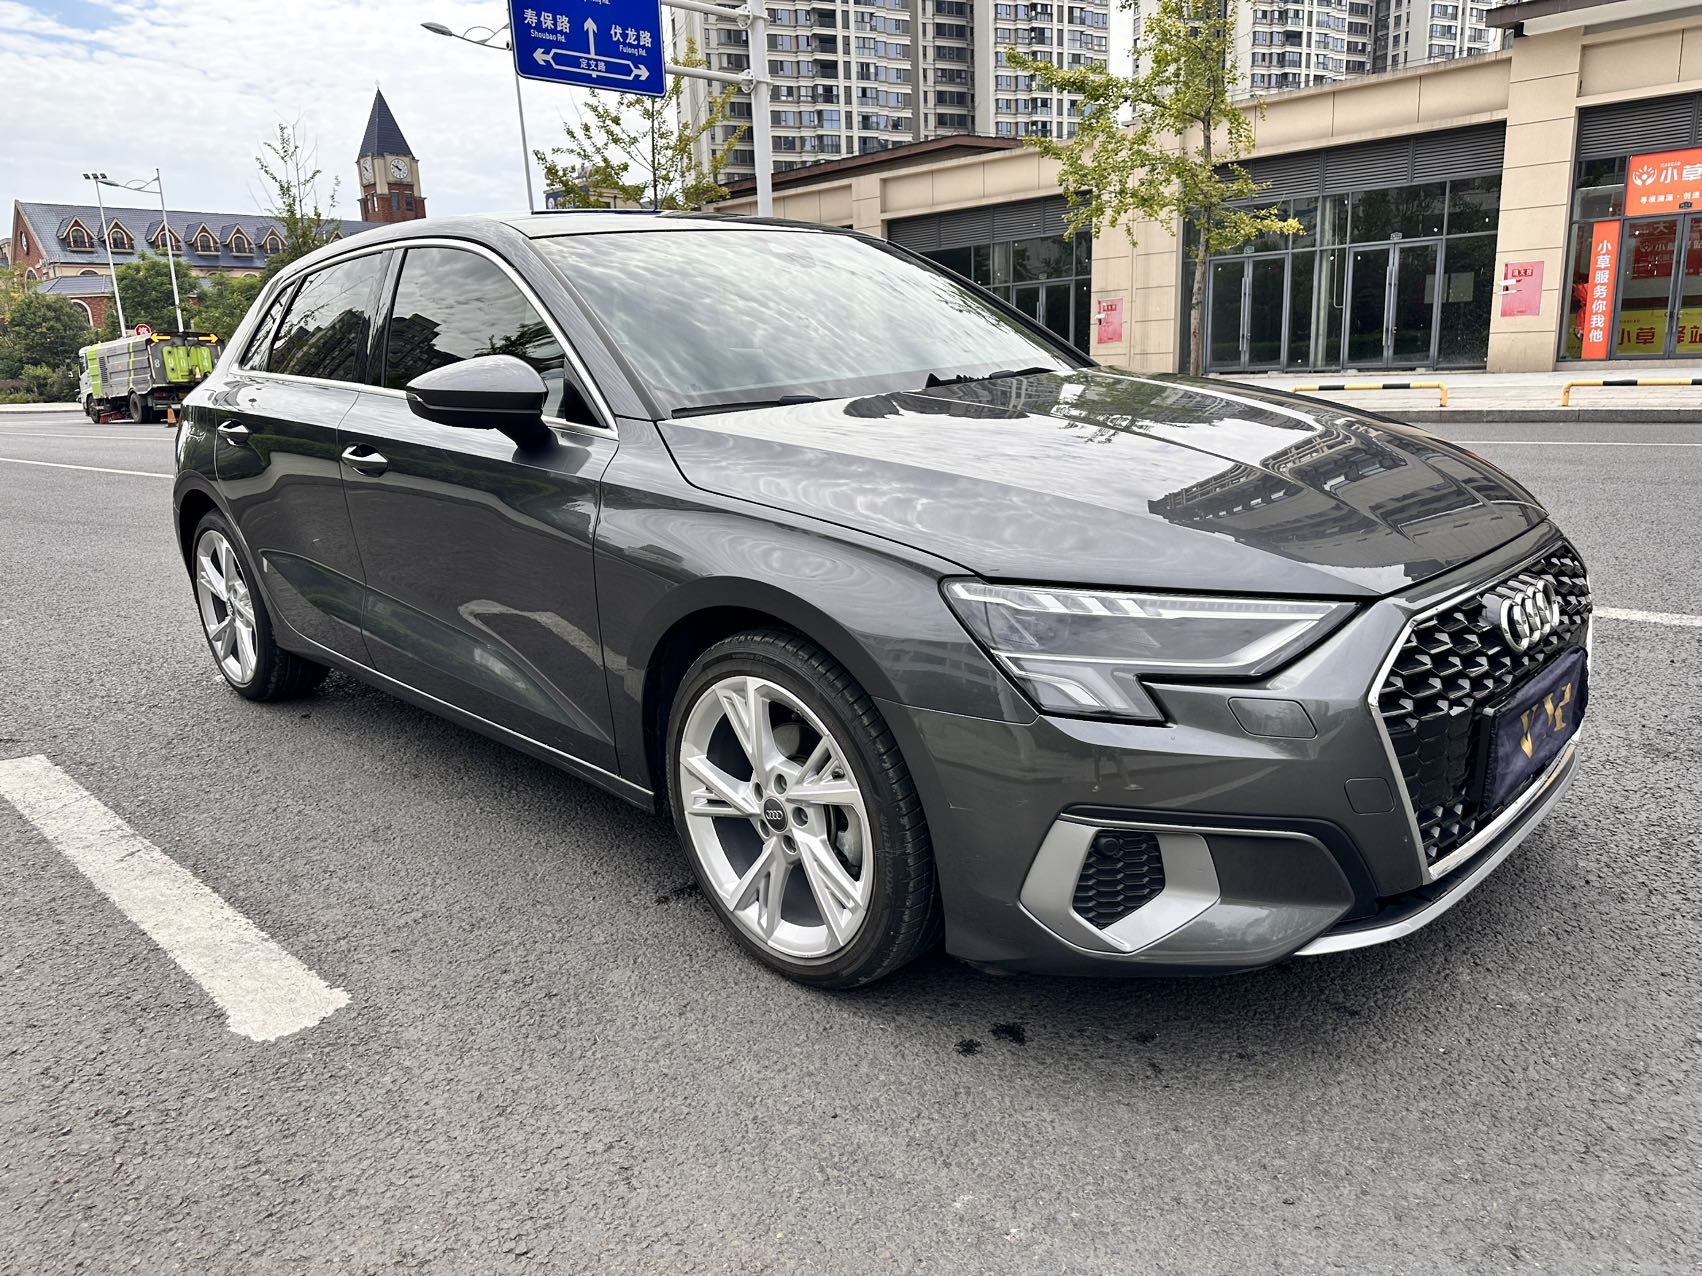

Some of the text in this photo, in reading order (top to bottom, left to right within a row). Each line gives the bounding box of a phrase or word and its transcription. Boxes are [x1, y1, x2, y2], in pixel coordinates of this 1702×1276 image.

[524, 9, 570, 33] 寿保路
[530, 29, 557, 41] Shoubao
[610, 24, 652, 48] 伏龙路
[619, 45, 638, 56] Fulong
[1659, 163, 1702, 184] 小草
[1589, 239, 1612, 343] 小草服务你我他
